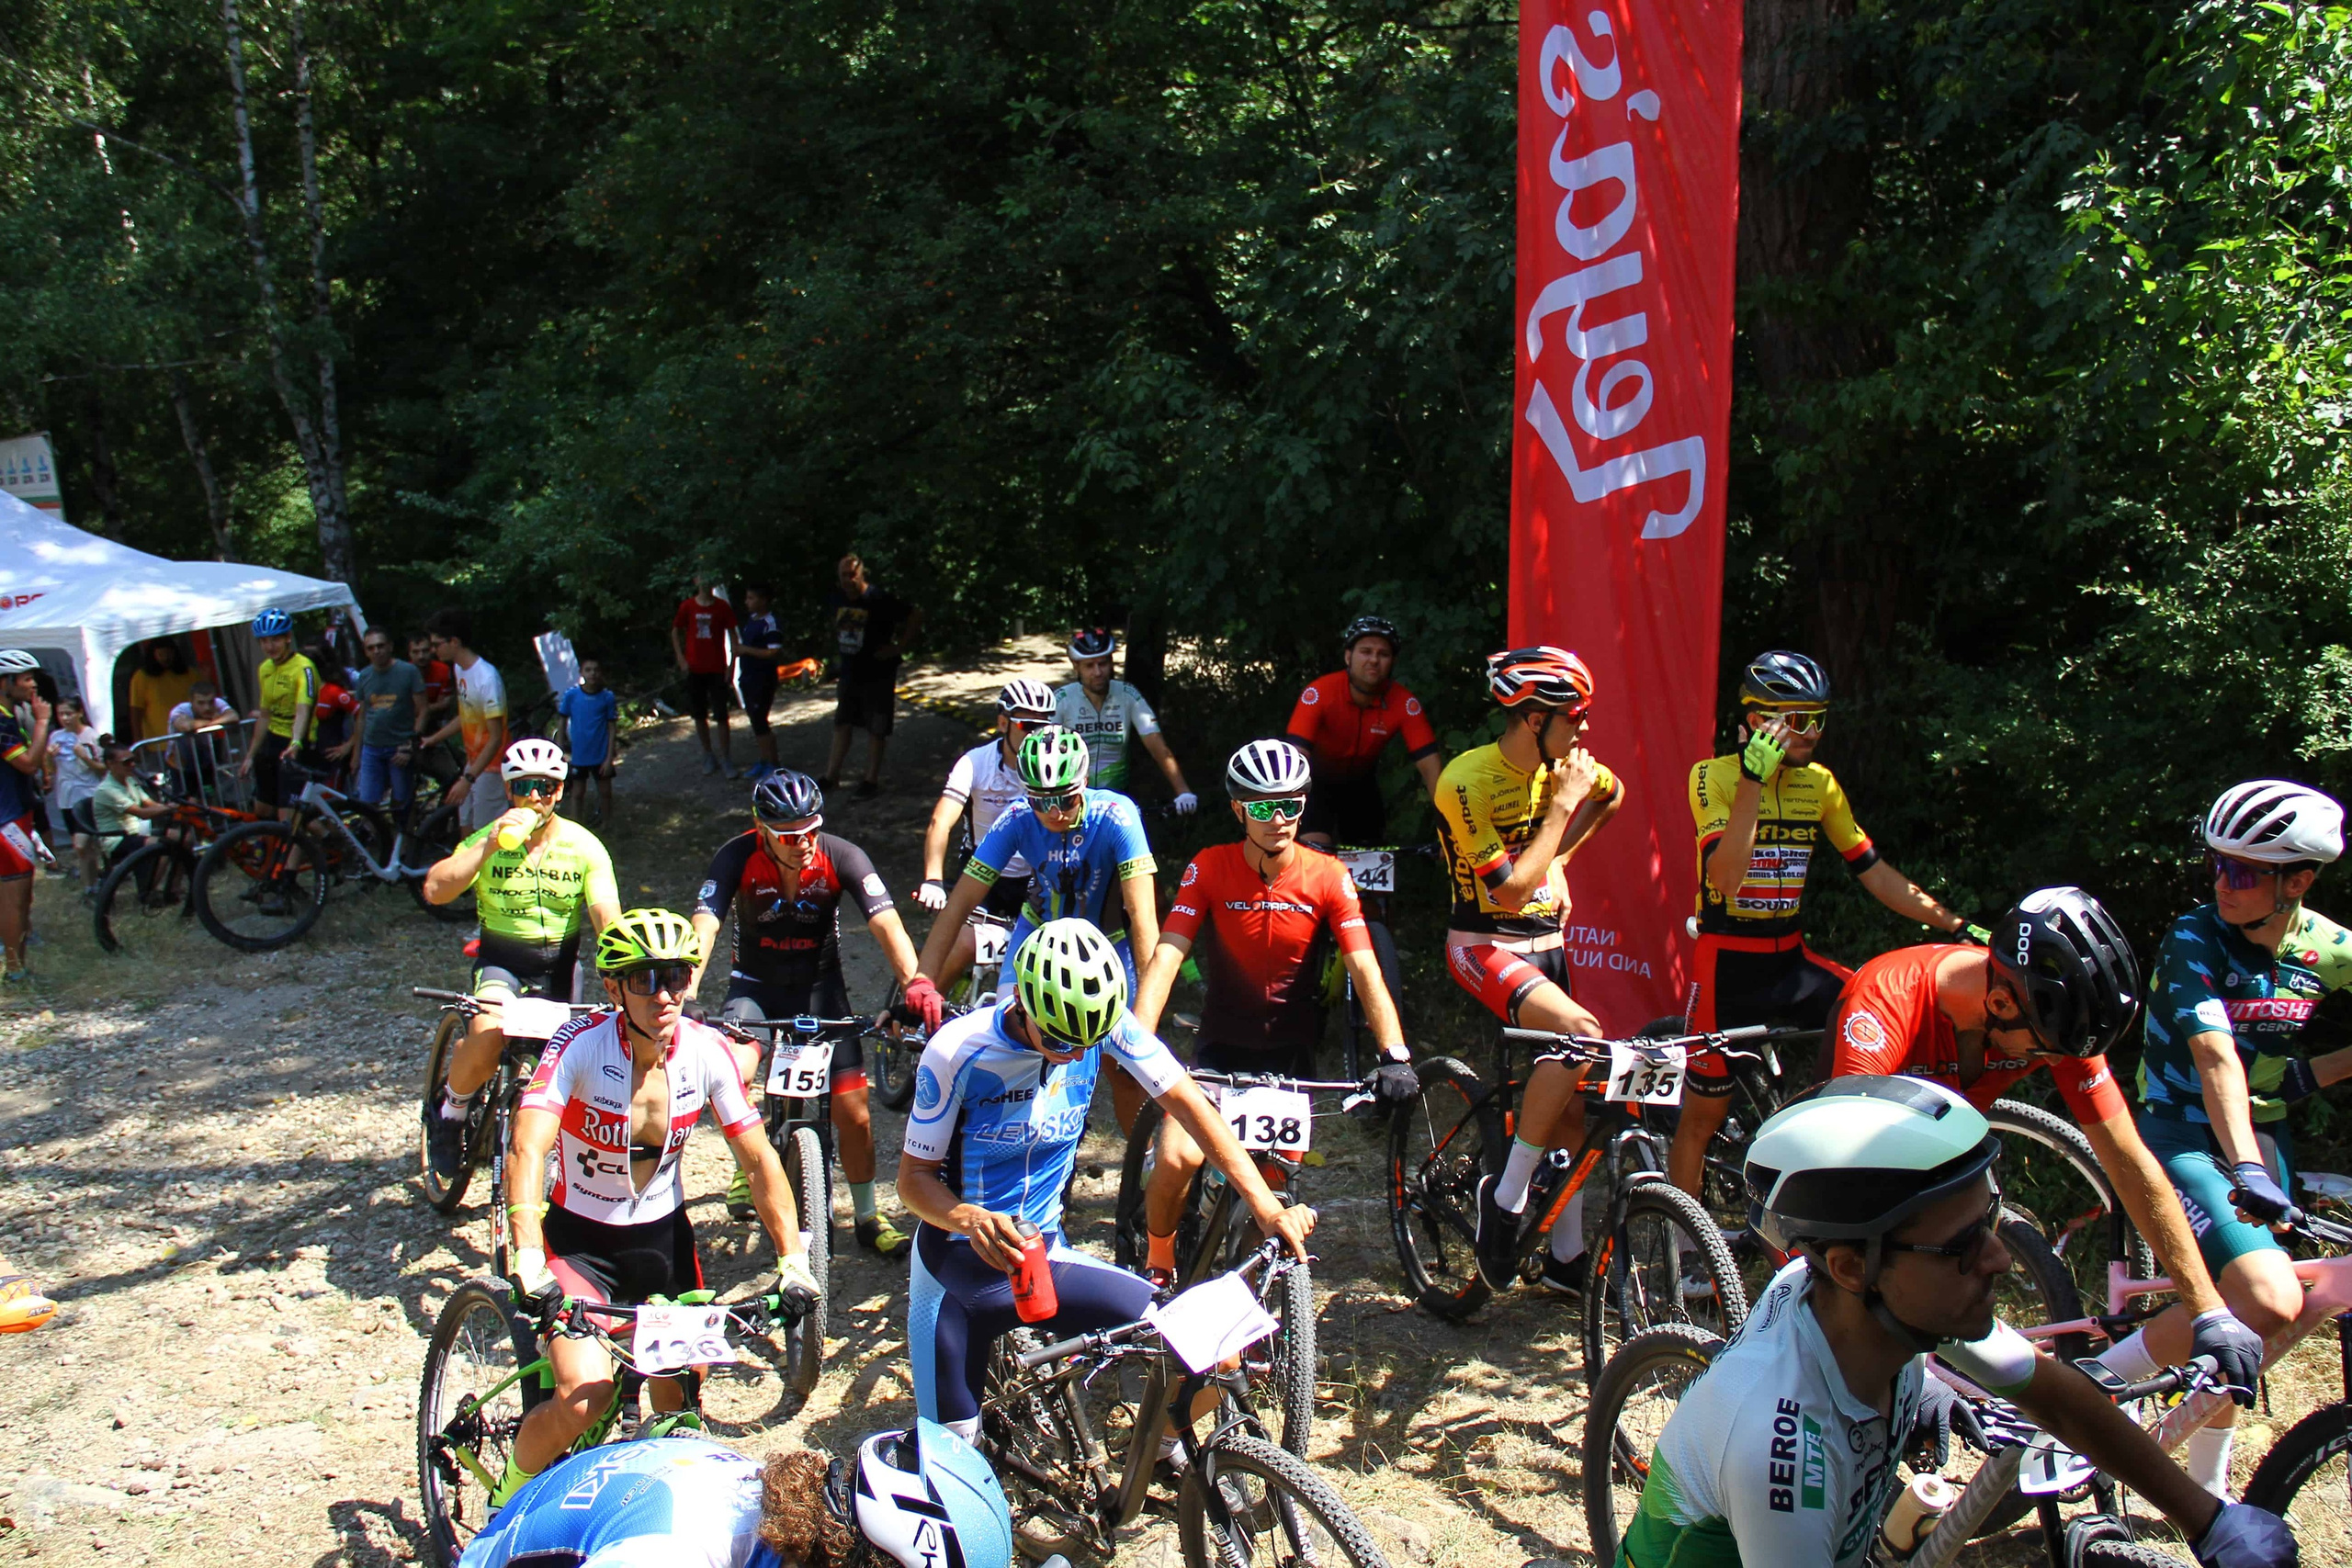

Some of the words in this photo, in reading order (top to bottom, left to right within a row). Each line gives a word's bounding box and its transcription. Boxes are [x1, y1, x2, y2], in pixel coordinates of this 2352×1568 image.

[1075, 721, 1125, 734] BEROE
[1697, 764, 1709, 808] efbet
[1455, 784, 1477, 837] efbet
[1047, 850, 1081, 863] HCA
[778, 1067, 826, 1092] 155
[1617, 1070, 1679, 1098] 135
[1231, 1114, 1301, 1145] 138
[645, 1338, 722, 1366] 136
[1770, 1397, 1801, 1514] BEROE
[1804, 1429, 1825, 1488] MTB
